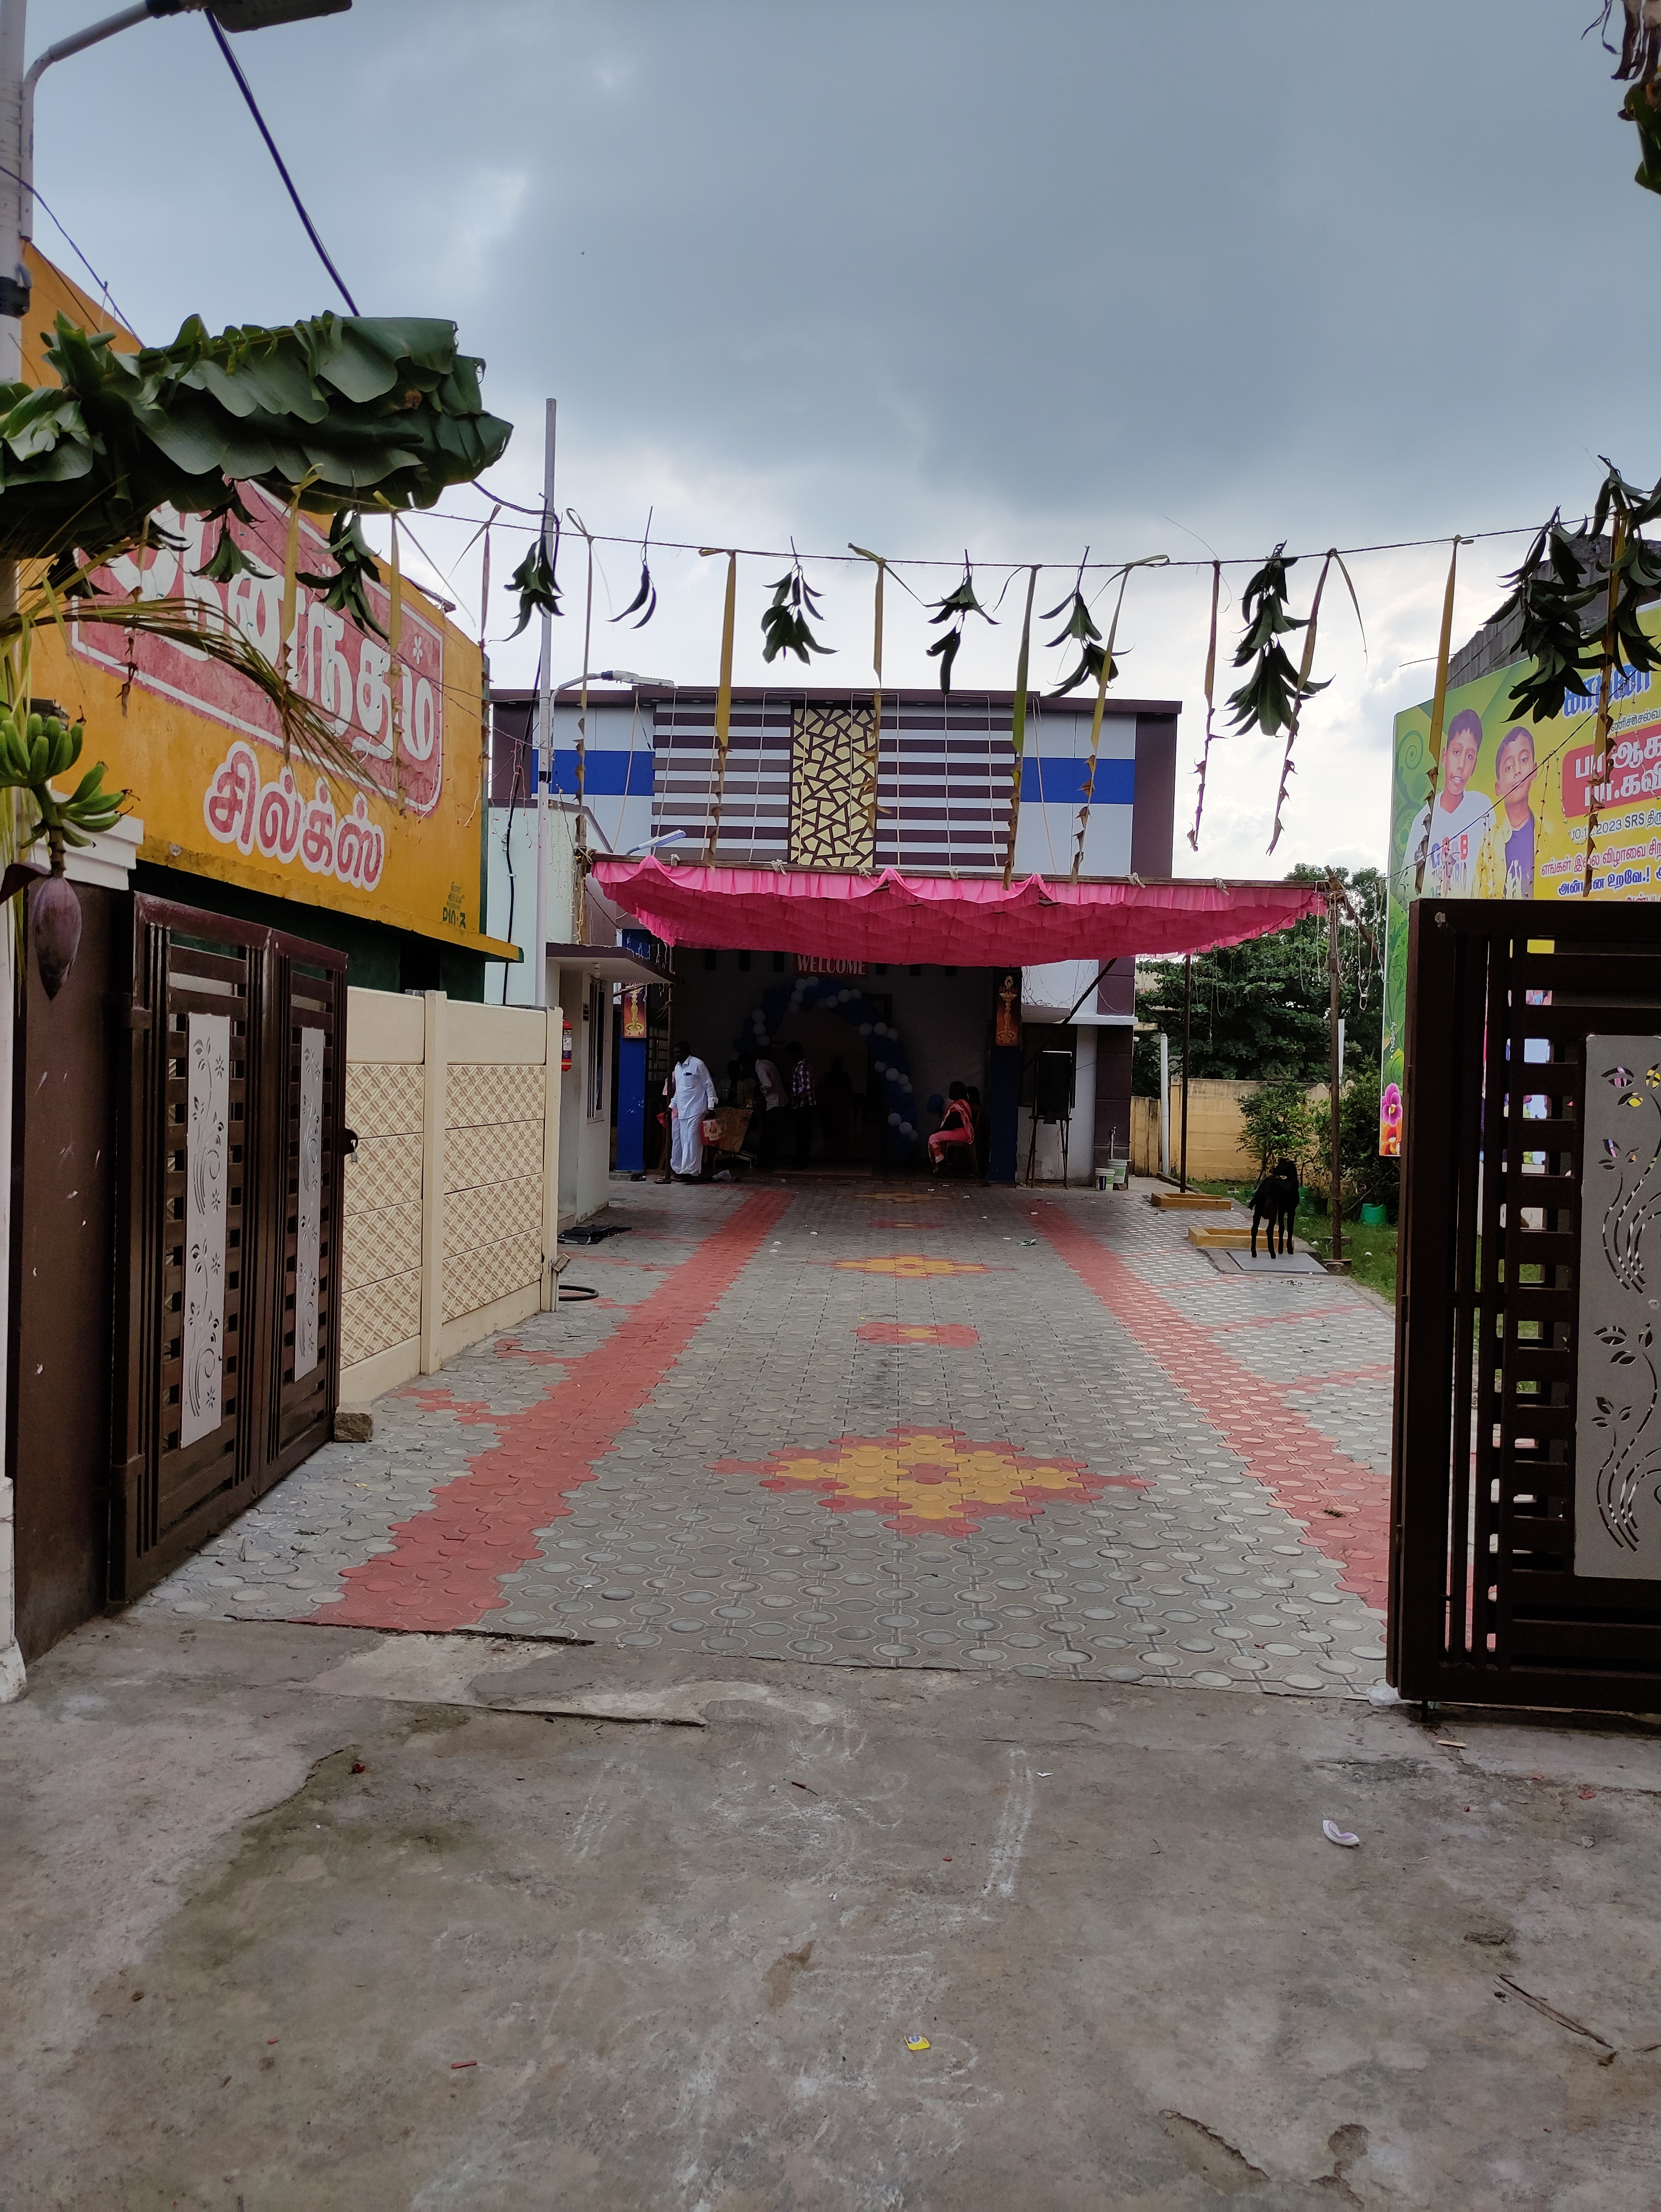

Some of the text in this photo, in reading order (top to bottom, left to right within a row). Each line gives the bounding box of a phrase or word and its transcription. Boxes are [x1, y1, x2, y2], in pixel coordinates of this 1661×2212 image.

[206, 744, 384, 890] சில்க்ஸ்
[1572, 819, 1622, 840] 10.1.2023
[1625, 812, 1645, 828] SRS
[1603, 846, 1646, 867] விழாவை
[797, 954, 866, 975] WELCOME
